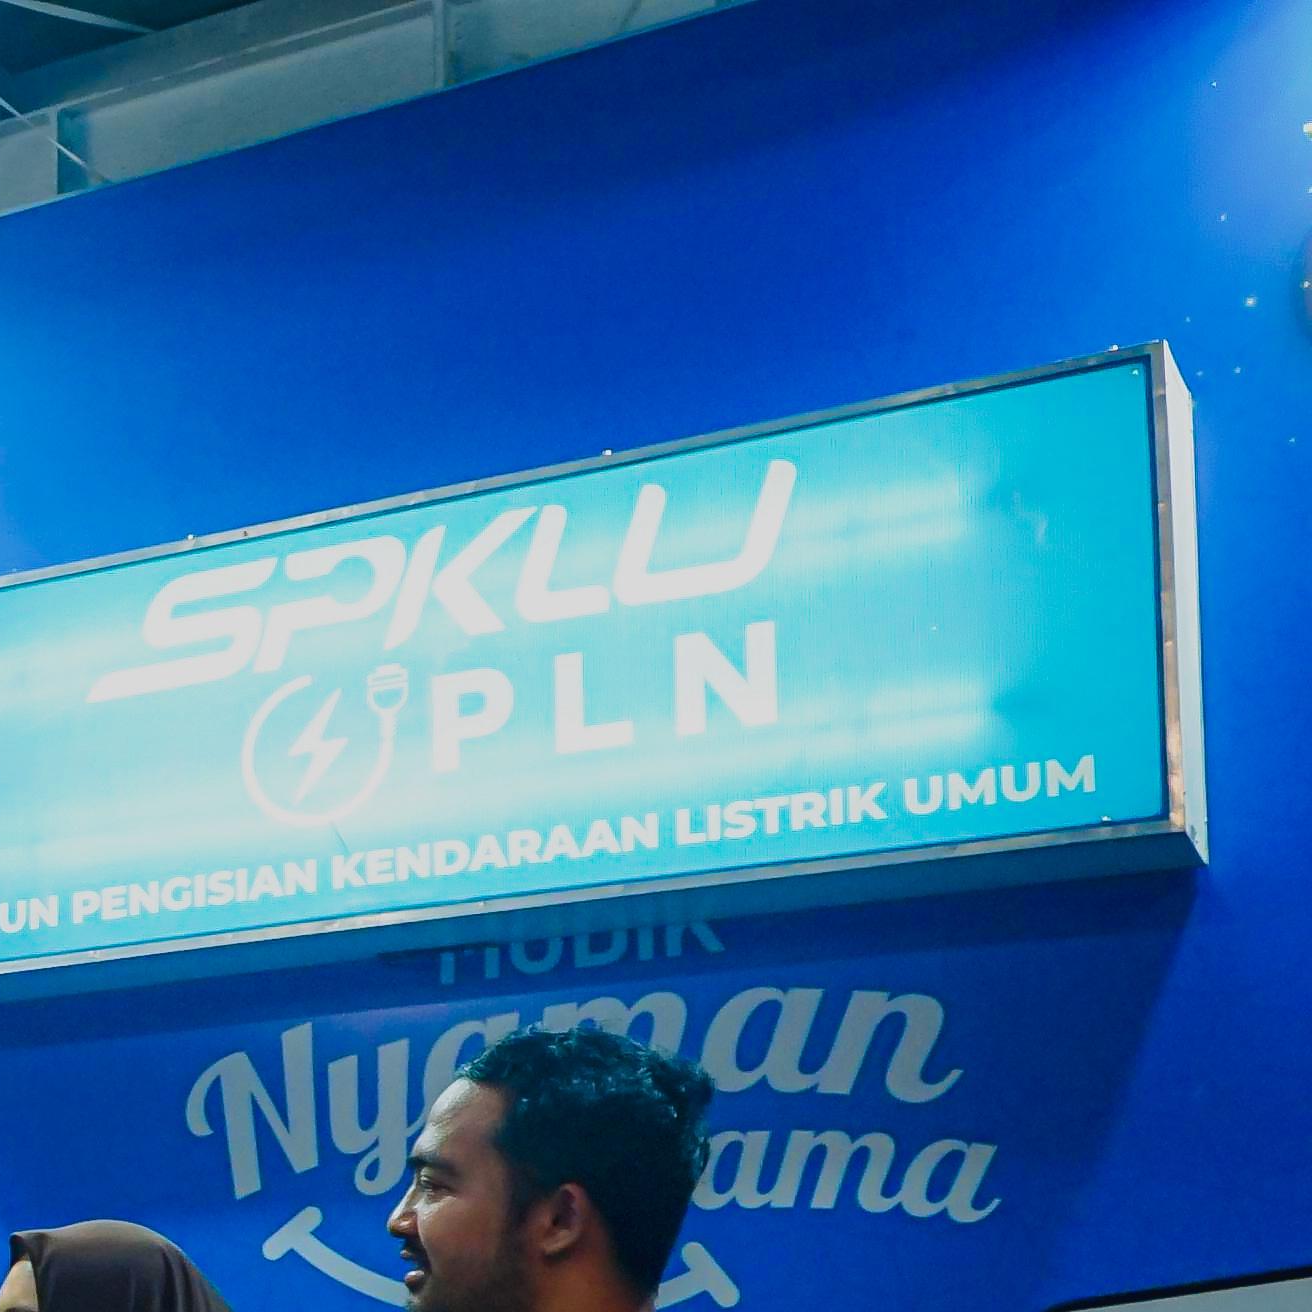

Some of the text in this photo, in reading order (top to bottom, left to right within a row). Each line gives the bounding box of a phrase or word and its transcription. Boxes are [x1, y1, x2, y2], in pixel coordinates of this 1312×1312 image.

[86, 457, 797, 703] SPKLU
[432, 621, 781, 775] PLN
[72, 859, 317, 925] PENGISIAN
[332, 811, 659, 890] KENDARAAN
[676, 781, 888, 846] LISTRIK
[904, 753, 1096, 815] UMUM
